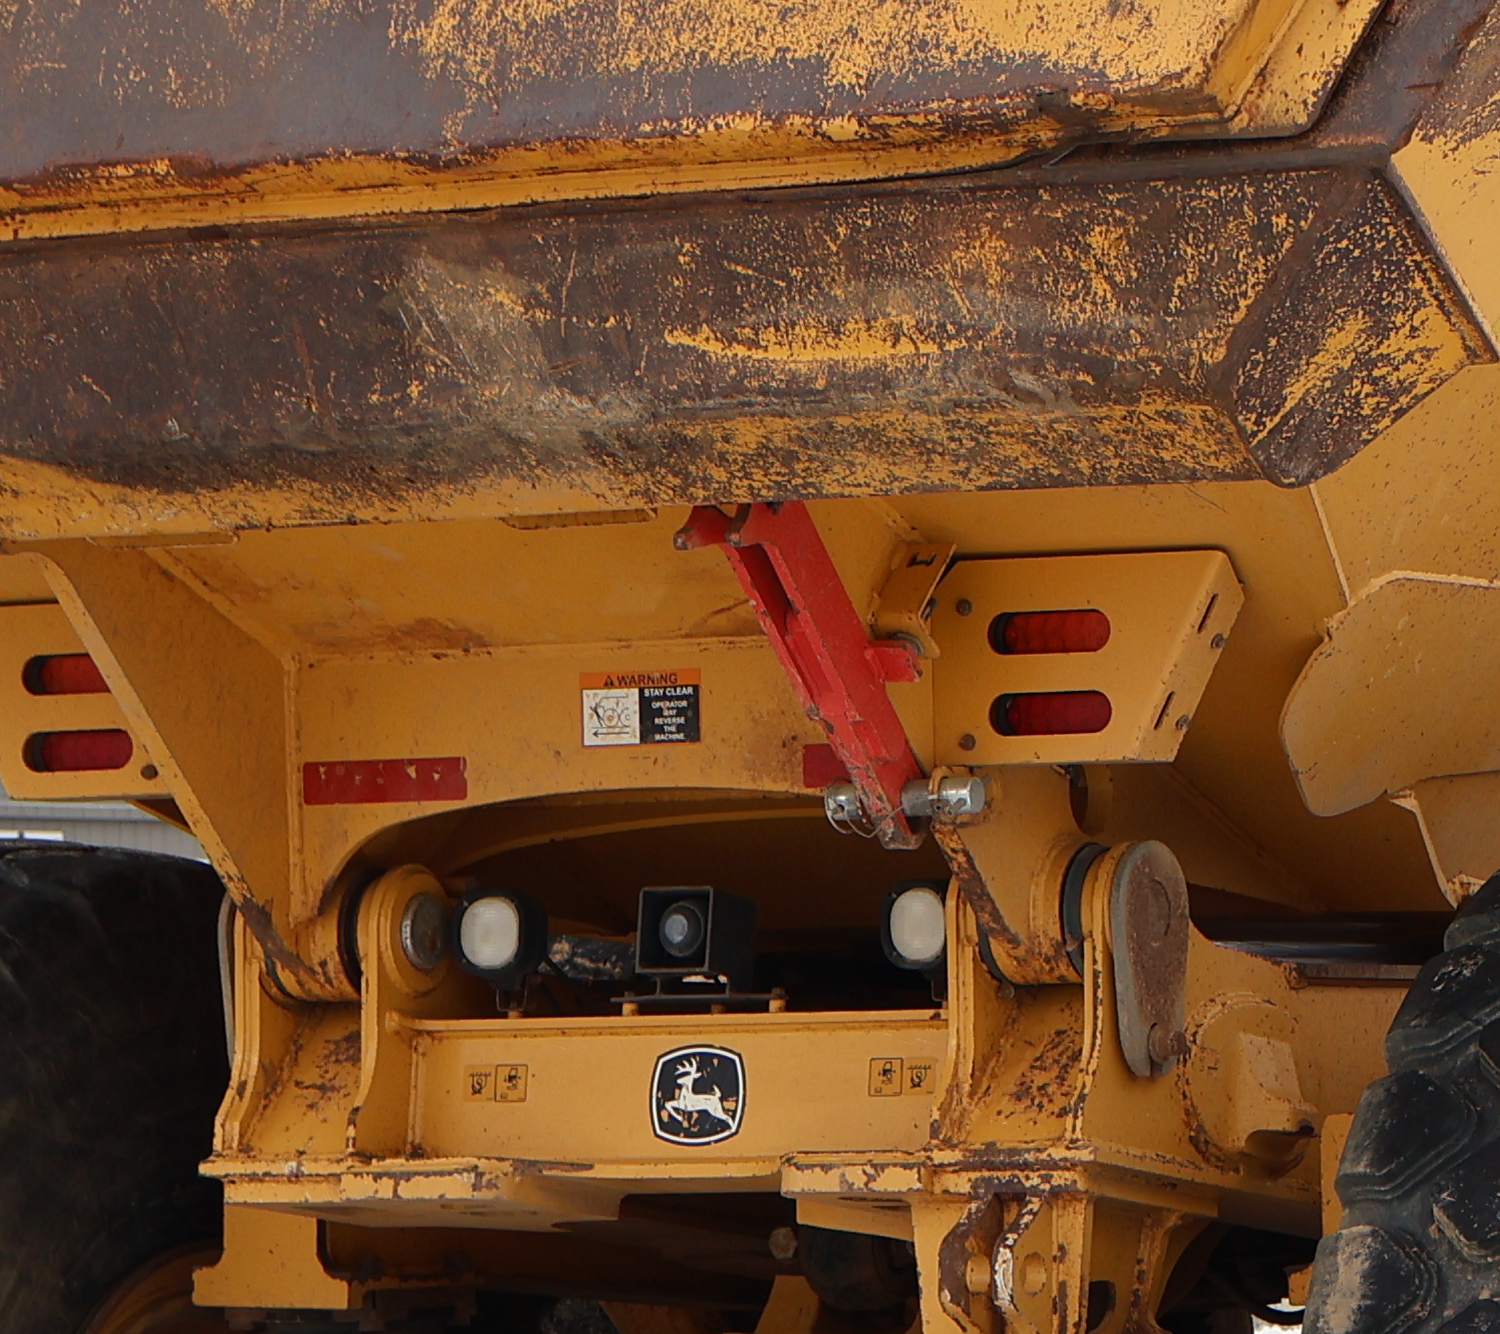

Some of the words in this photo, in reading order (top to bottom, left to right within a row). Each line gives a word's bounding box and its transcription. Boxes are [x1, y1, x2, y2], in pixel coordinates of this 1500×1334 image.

[617, 673, 678, 686] WARNING
[644, 689, 664, 697] STAY
[666, 687, 693, 696] CLEAR
